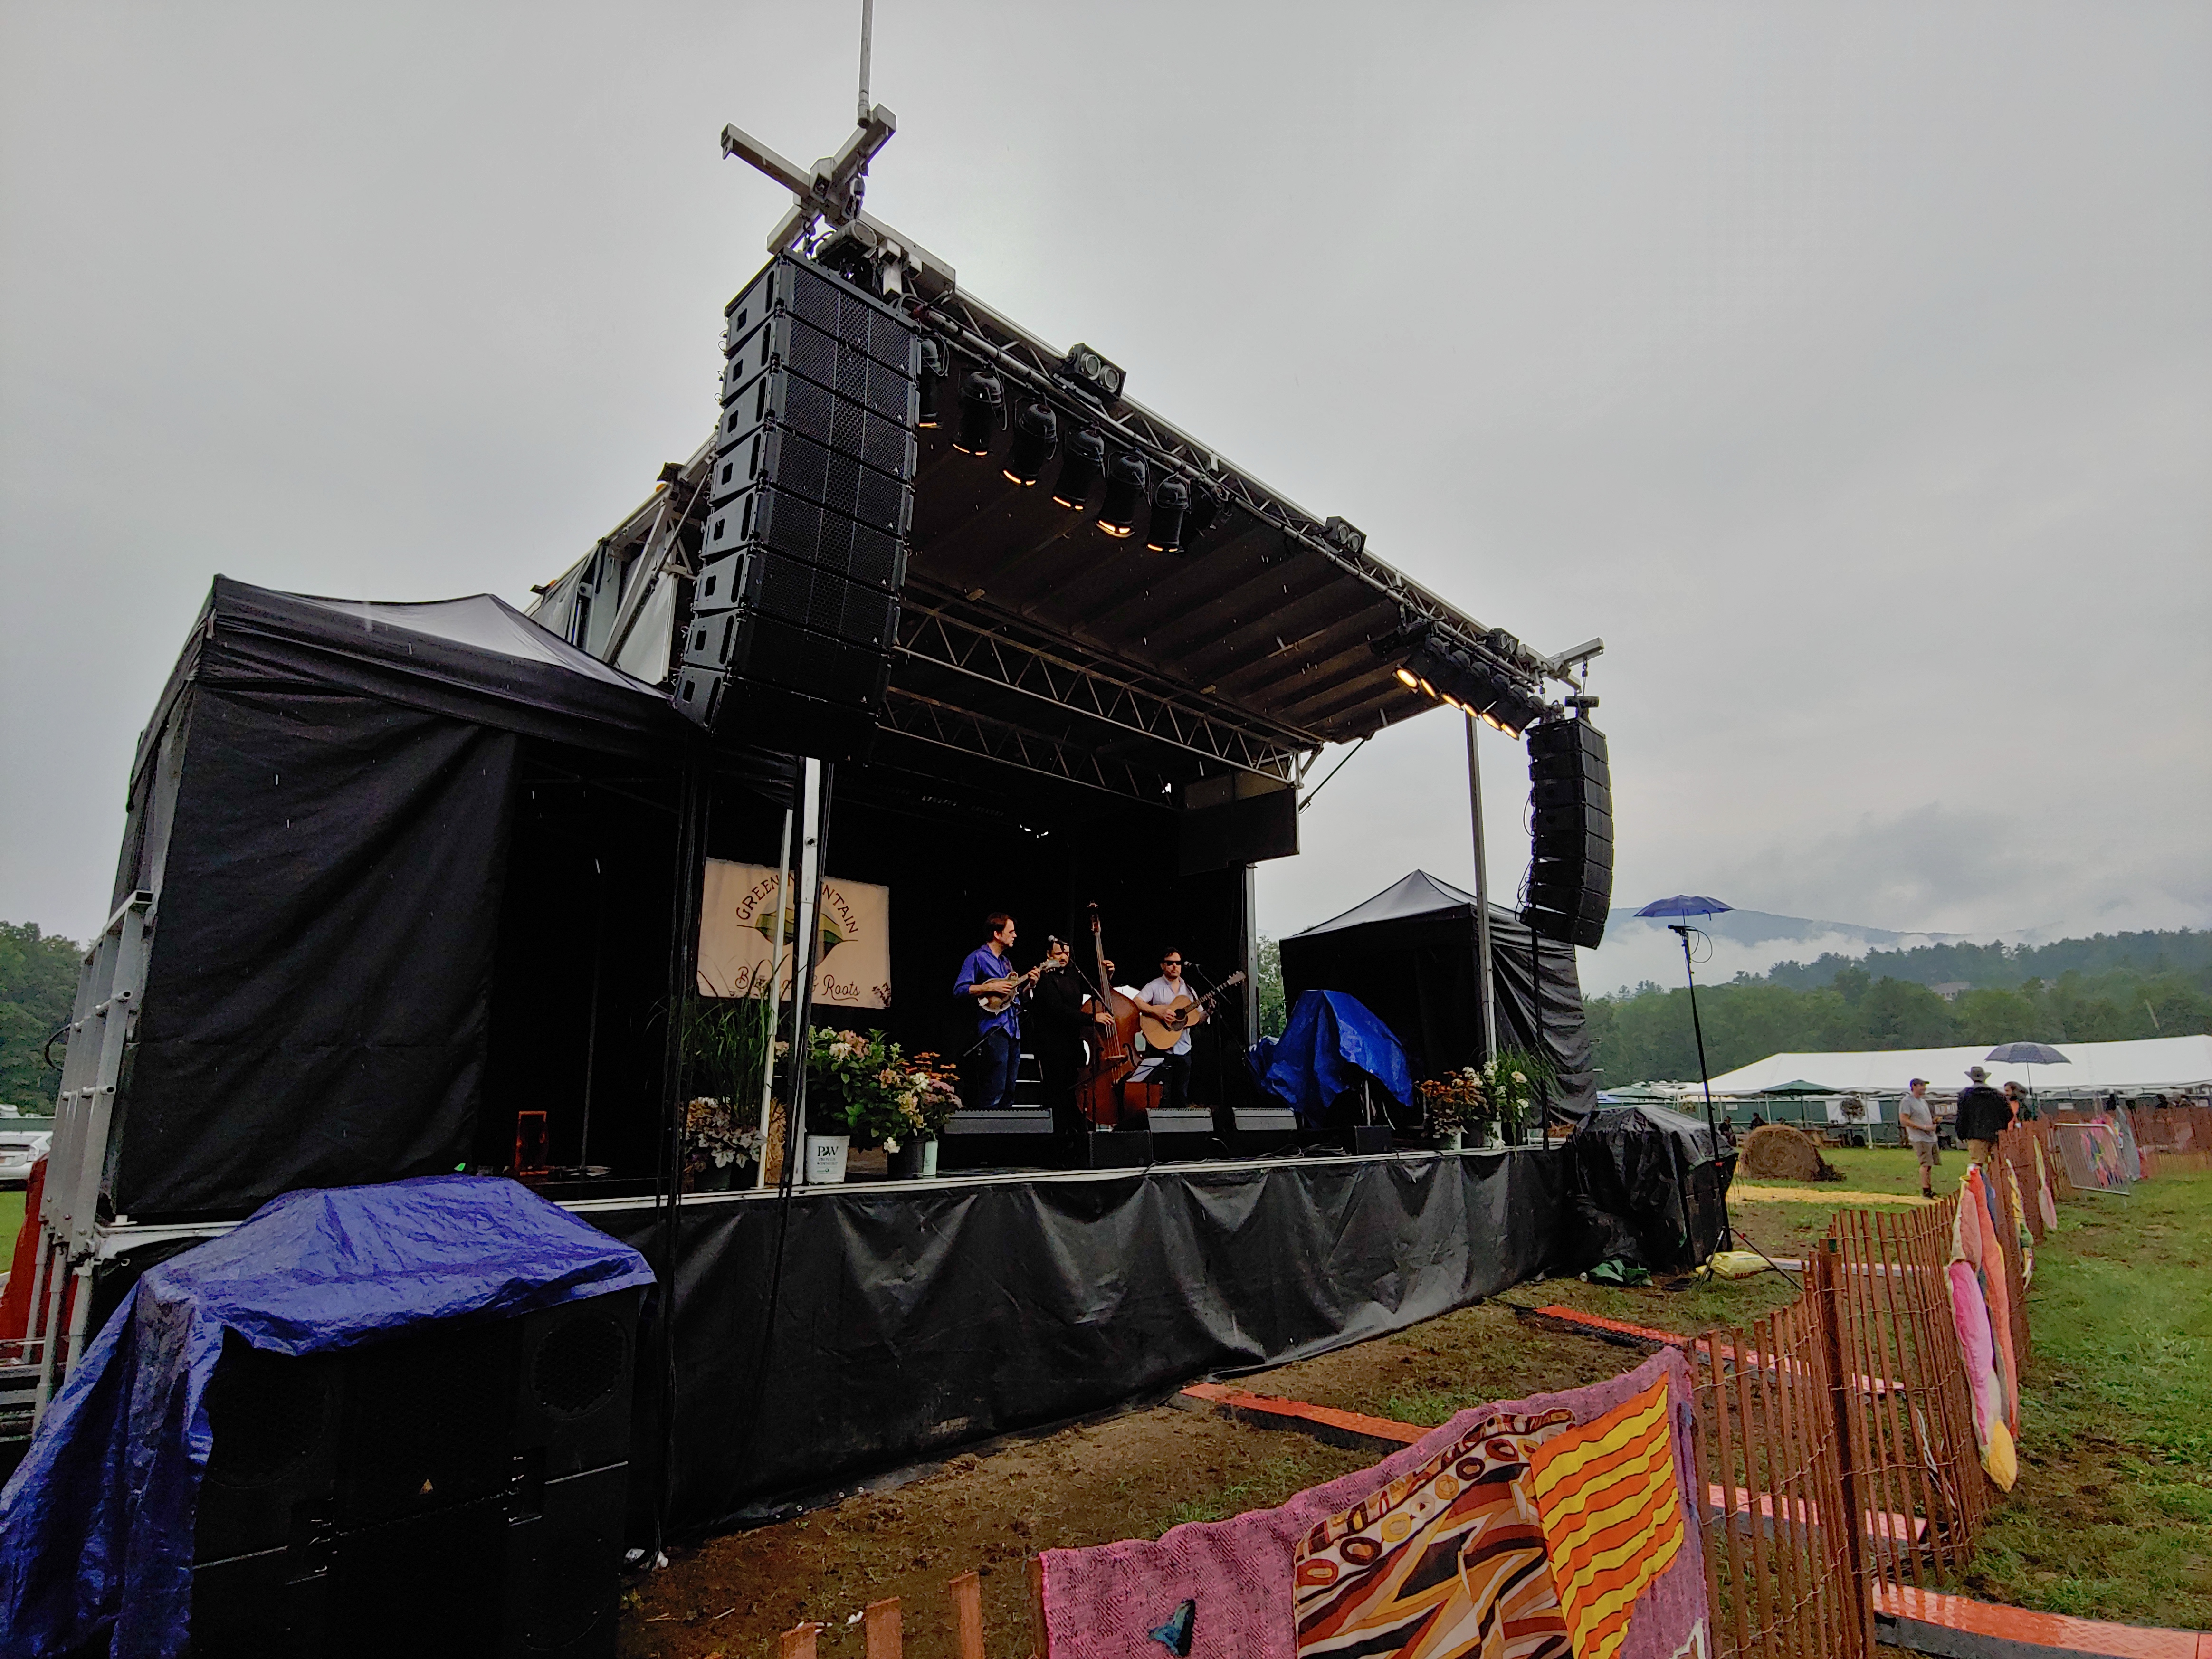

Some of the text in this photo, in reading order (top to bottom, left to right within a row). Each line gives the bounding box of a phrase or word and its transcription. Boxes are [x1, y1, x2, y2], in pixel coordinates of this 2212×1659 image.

[736, 873, 858, 934] GREEN NTAIN
[821, 974, 860, 1002] Roots
[818, 1146, 839, 1156] PW
